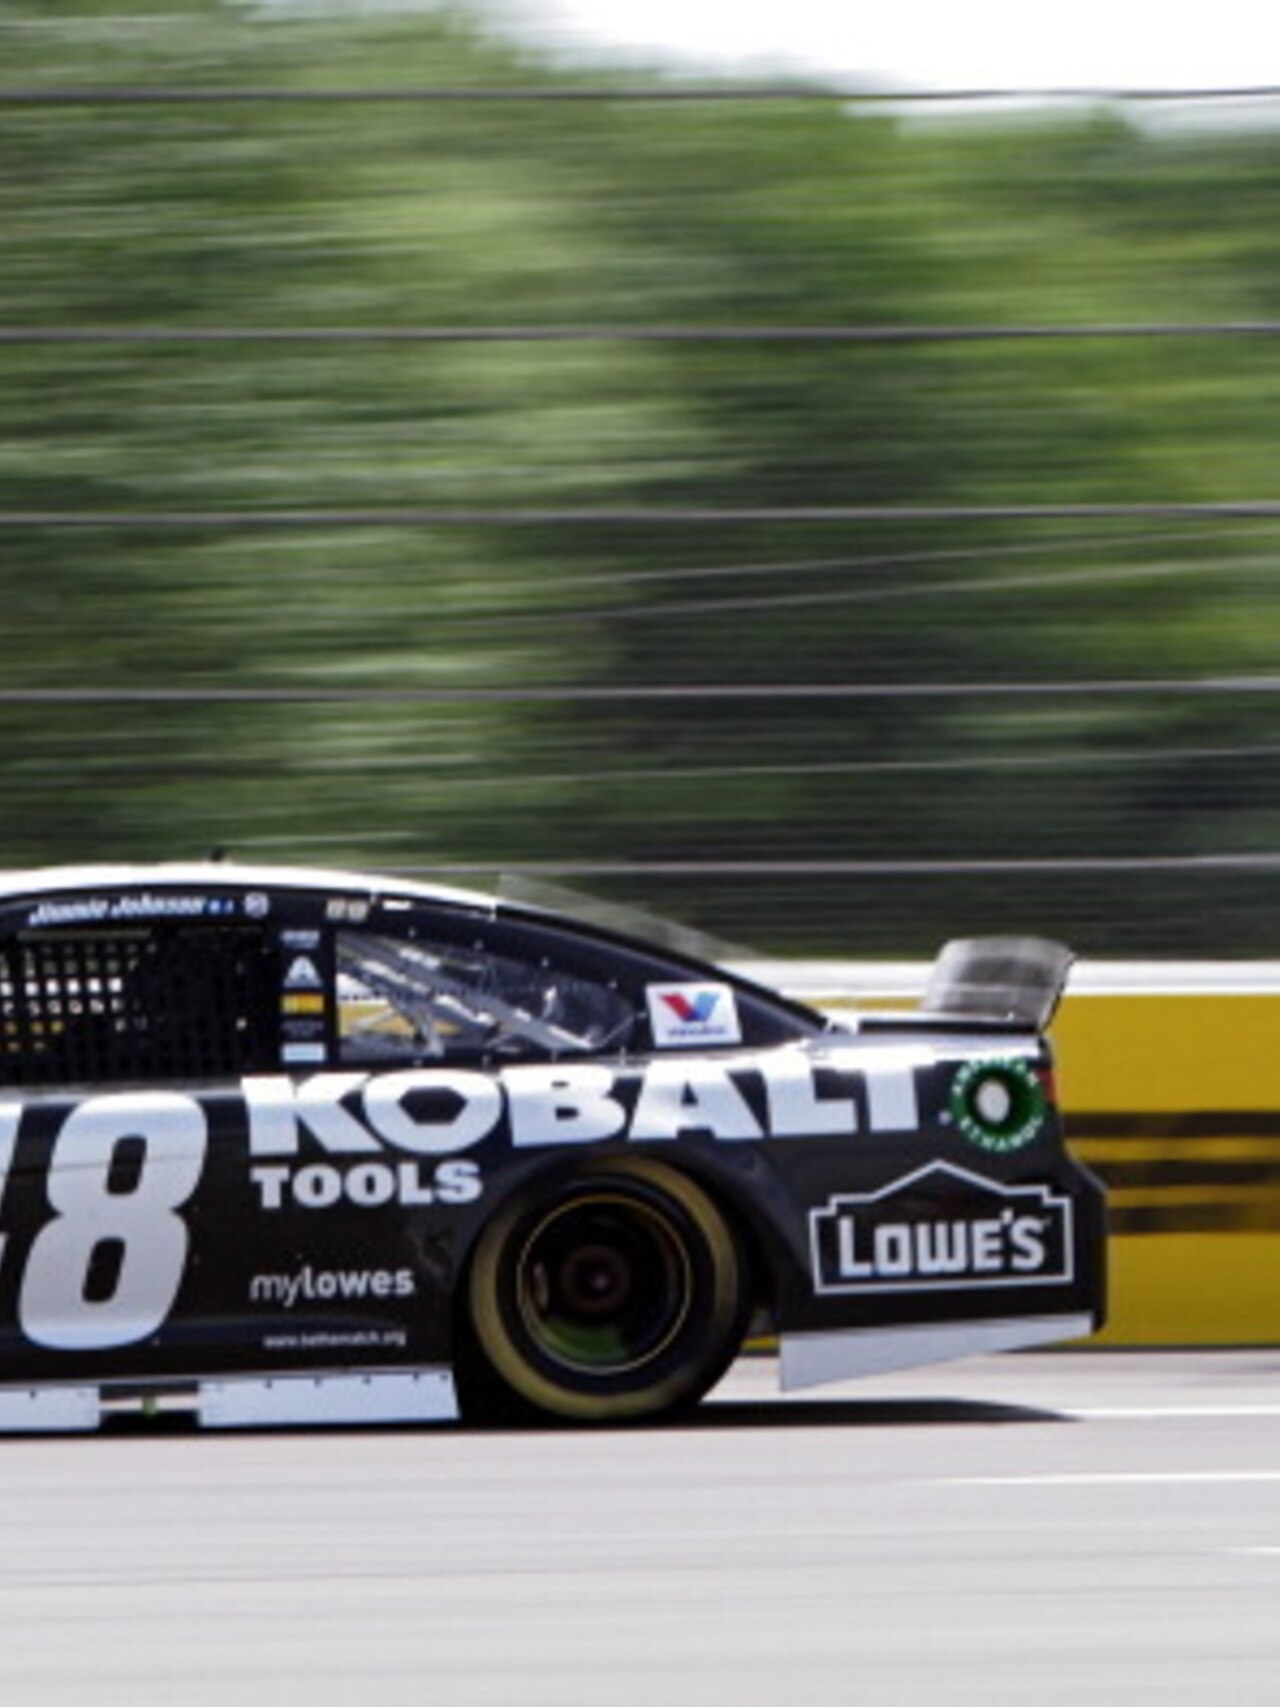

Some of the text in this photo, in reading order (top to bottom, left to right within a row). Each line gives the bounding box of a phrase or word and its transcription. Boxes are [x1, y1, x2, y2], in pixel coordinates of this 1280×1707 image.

[241, 1047, 937, 1154] KOBALT
[250, 1161, 483, 1208] TOOLS
[838, 1208, 1045, 1277] LOWE'S
